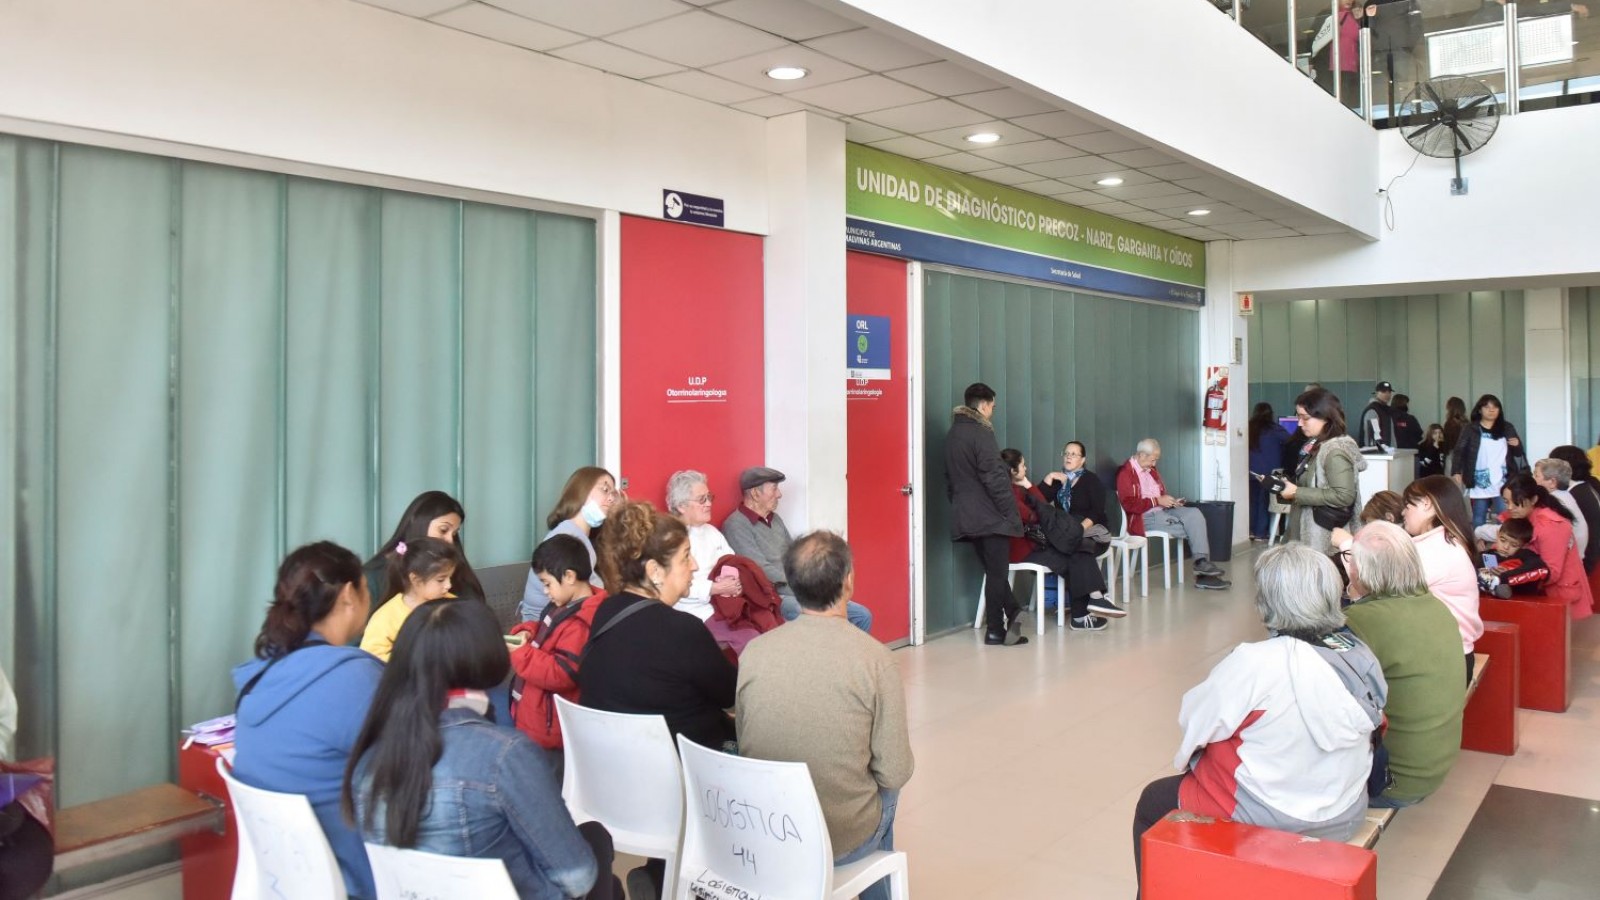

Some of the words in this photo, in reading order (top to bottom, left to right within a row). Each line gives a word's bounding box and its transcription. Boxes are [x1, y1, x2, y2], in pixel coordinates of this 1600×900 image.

[857, 167, 920, 203] UNIDAD
[924, 184, 943, 209] DE
[945, 190, 1036, 232] DIAGNÓSTICO
[1038, 214, 1080, 242] PRECOZ
[1086, 226, 1116, 254] NARIZ,
[1117, 236, 1162, 262] GARGANTA
[1162, 247, 1169, 262] Y
[1169, 246, 1193, 268] OÍDOS
[868, 230, 876, 239] DE
[870, 239, 902, 252] ARGENTINAS
[856, 319, 869, 330] ORL
[732, 843, 757, 876] 44
